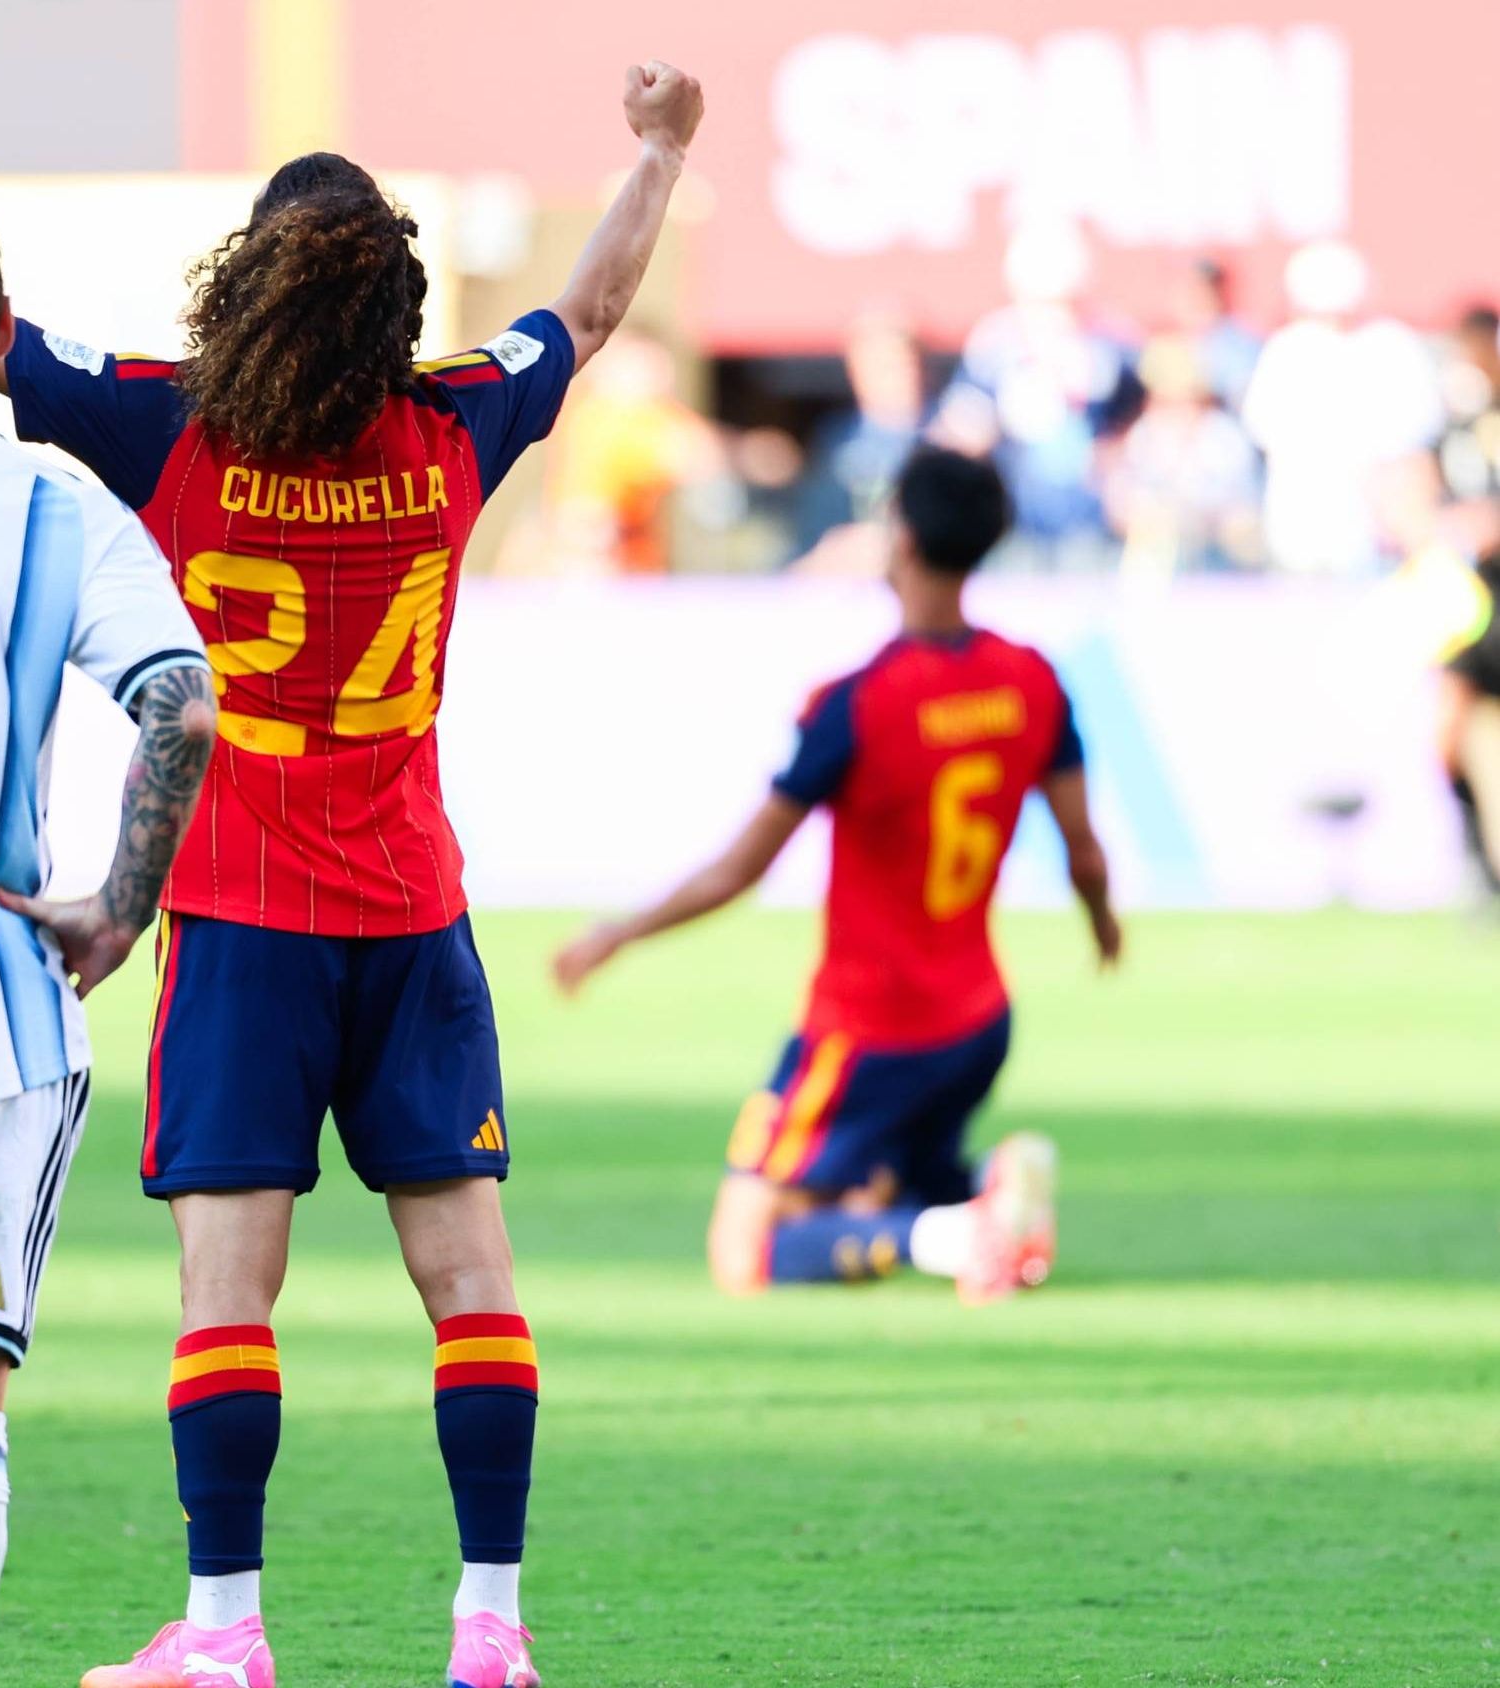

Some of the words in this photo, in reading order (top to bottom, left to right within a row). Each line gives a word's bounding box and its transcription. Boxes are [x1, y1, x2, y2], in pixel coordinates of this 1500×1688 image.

[772, 24, 1350, 252] SPAIN
[219, 465, 449, 523] CUCURELLA
[183, 547, 451, 757] 24
[923, 751, 1004, 922] 6
